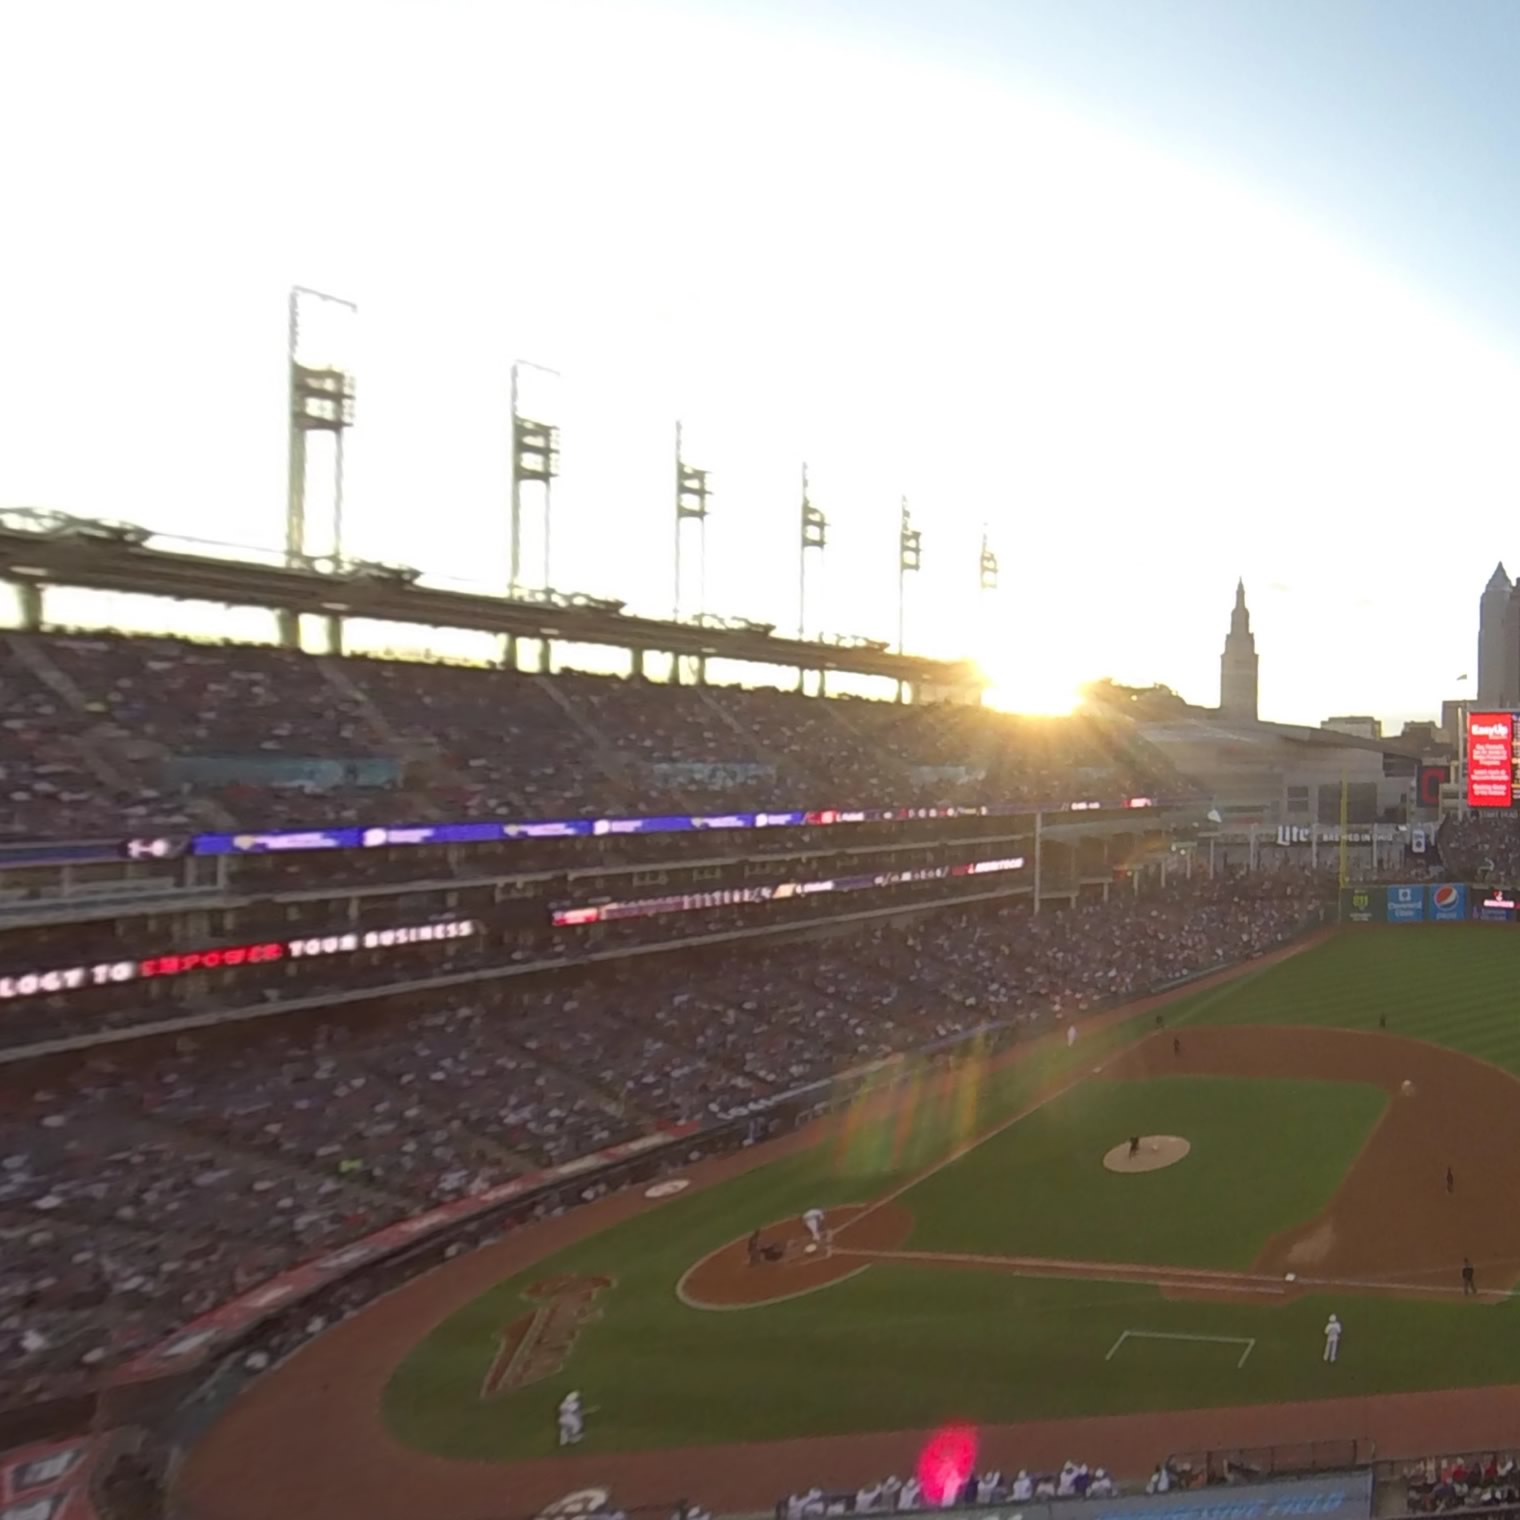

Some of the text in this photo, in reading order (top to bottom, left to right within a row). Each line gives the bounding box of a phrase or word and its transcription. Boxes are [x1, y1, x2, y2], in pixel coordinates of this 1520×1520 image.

[1276, 825, 1311, 846] Lite
[92, 960, 137, 985] TO
[140, 943, 283, 977] EMPOWER
[289, 933, 358, 958] YOUR
[363, 919, 474, 949] BUSINESS
